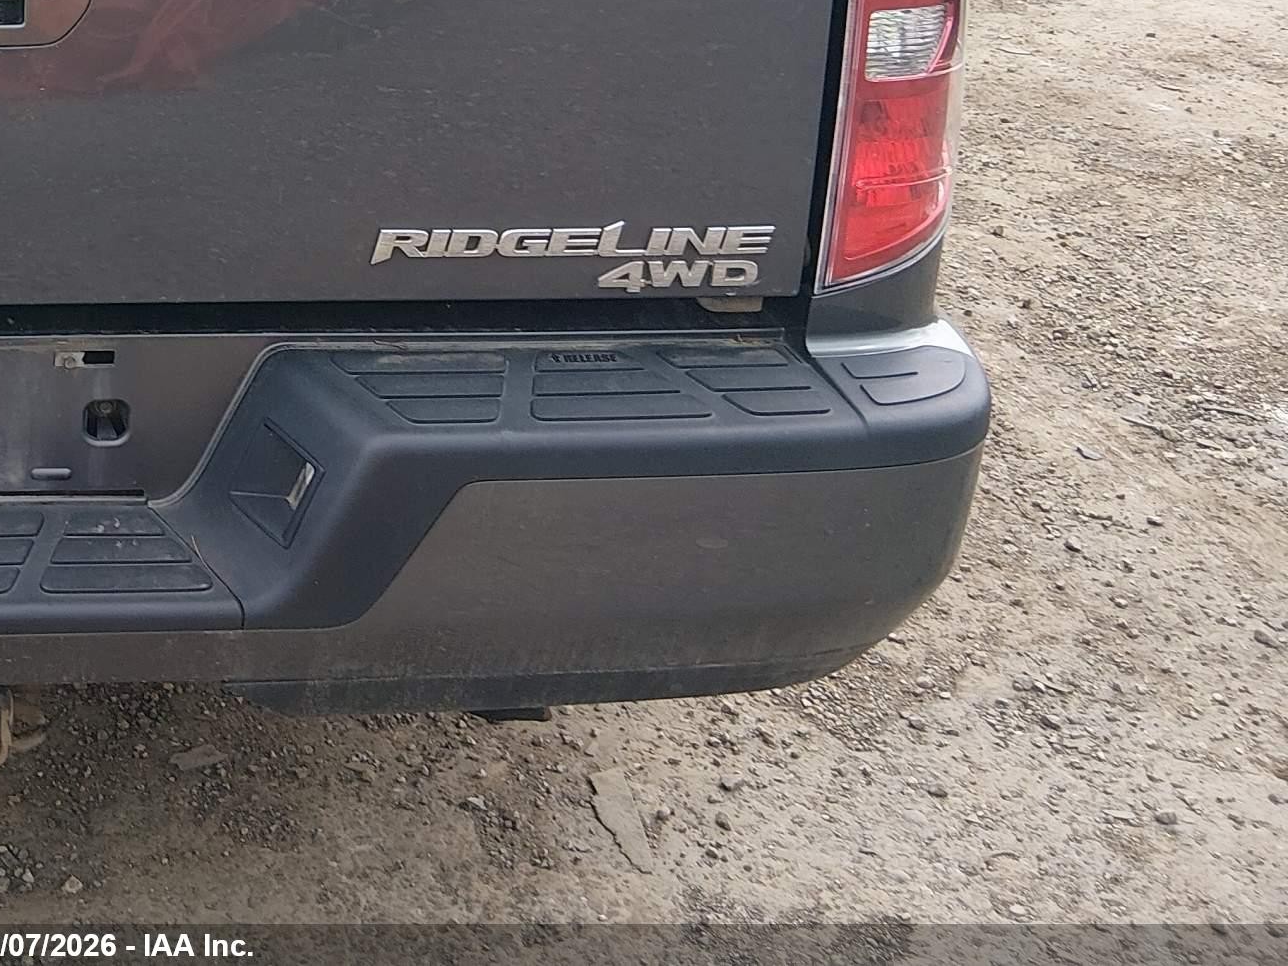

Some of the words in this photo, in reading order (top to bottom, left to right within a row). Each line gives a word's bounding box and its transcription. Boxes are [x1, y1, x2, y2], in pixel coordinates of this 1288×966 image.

[370, 220, 776, 266] RIDGELINE
[597, 260, 760, 294] 4WD
[563, 353, 617, 363] RELEASE
